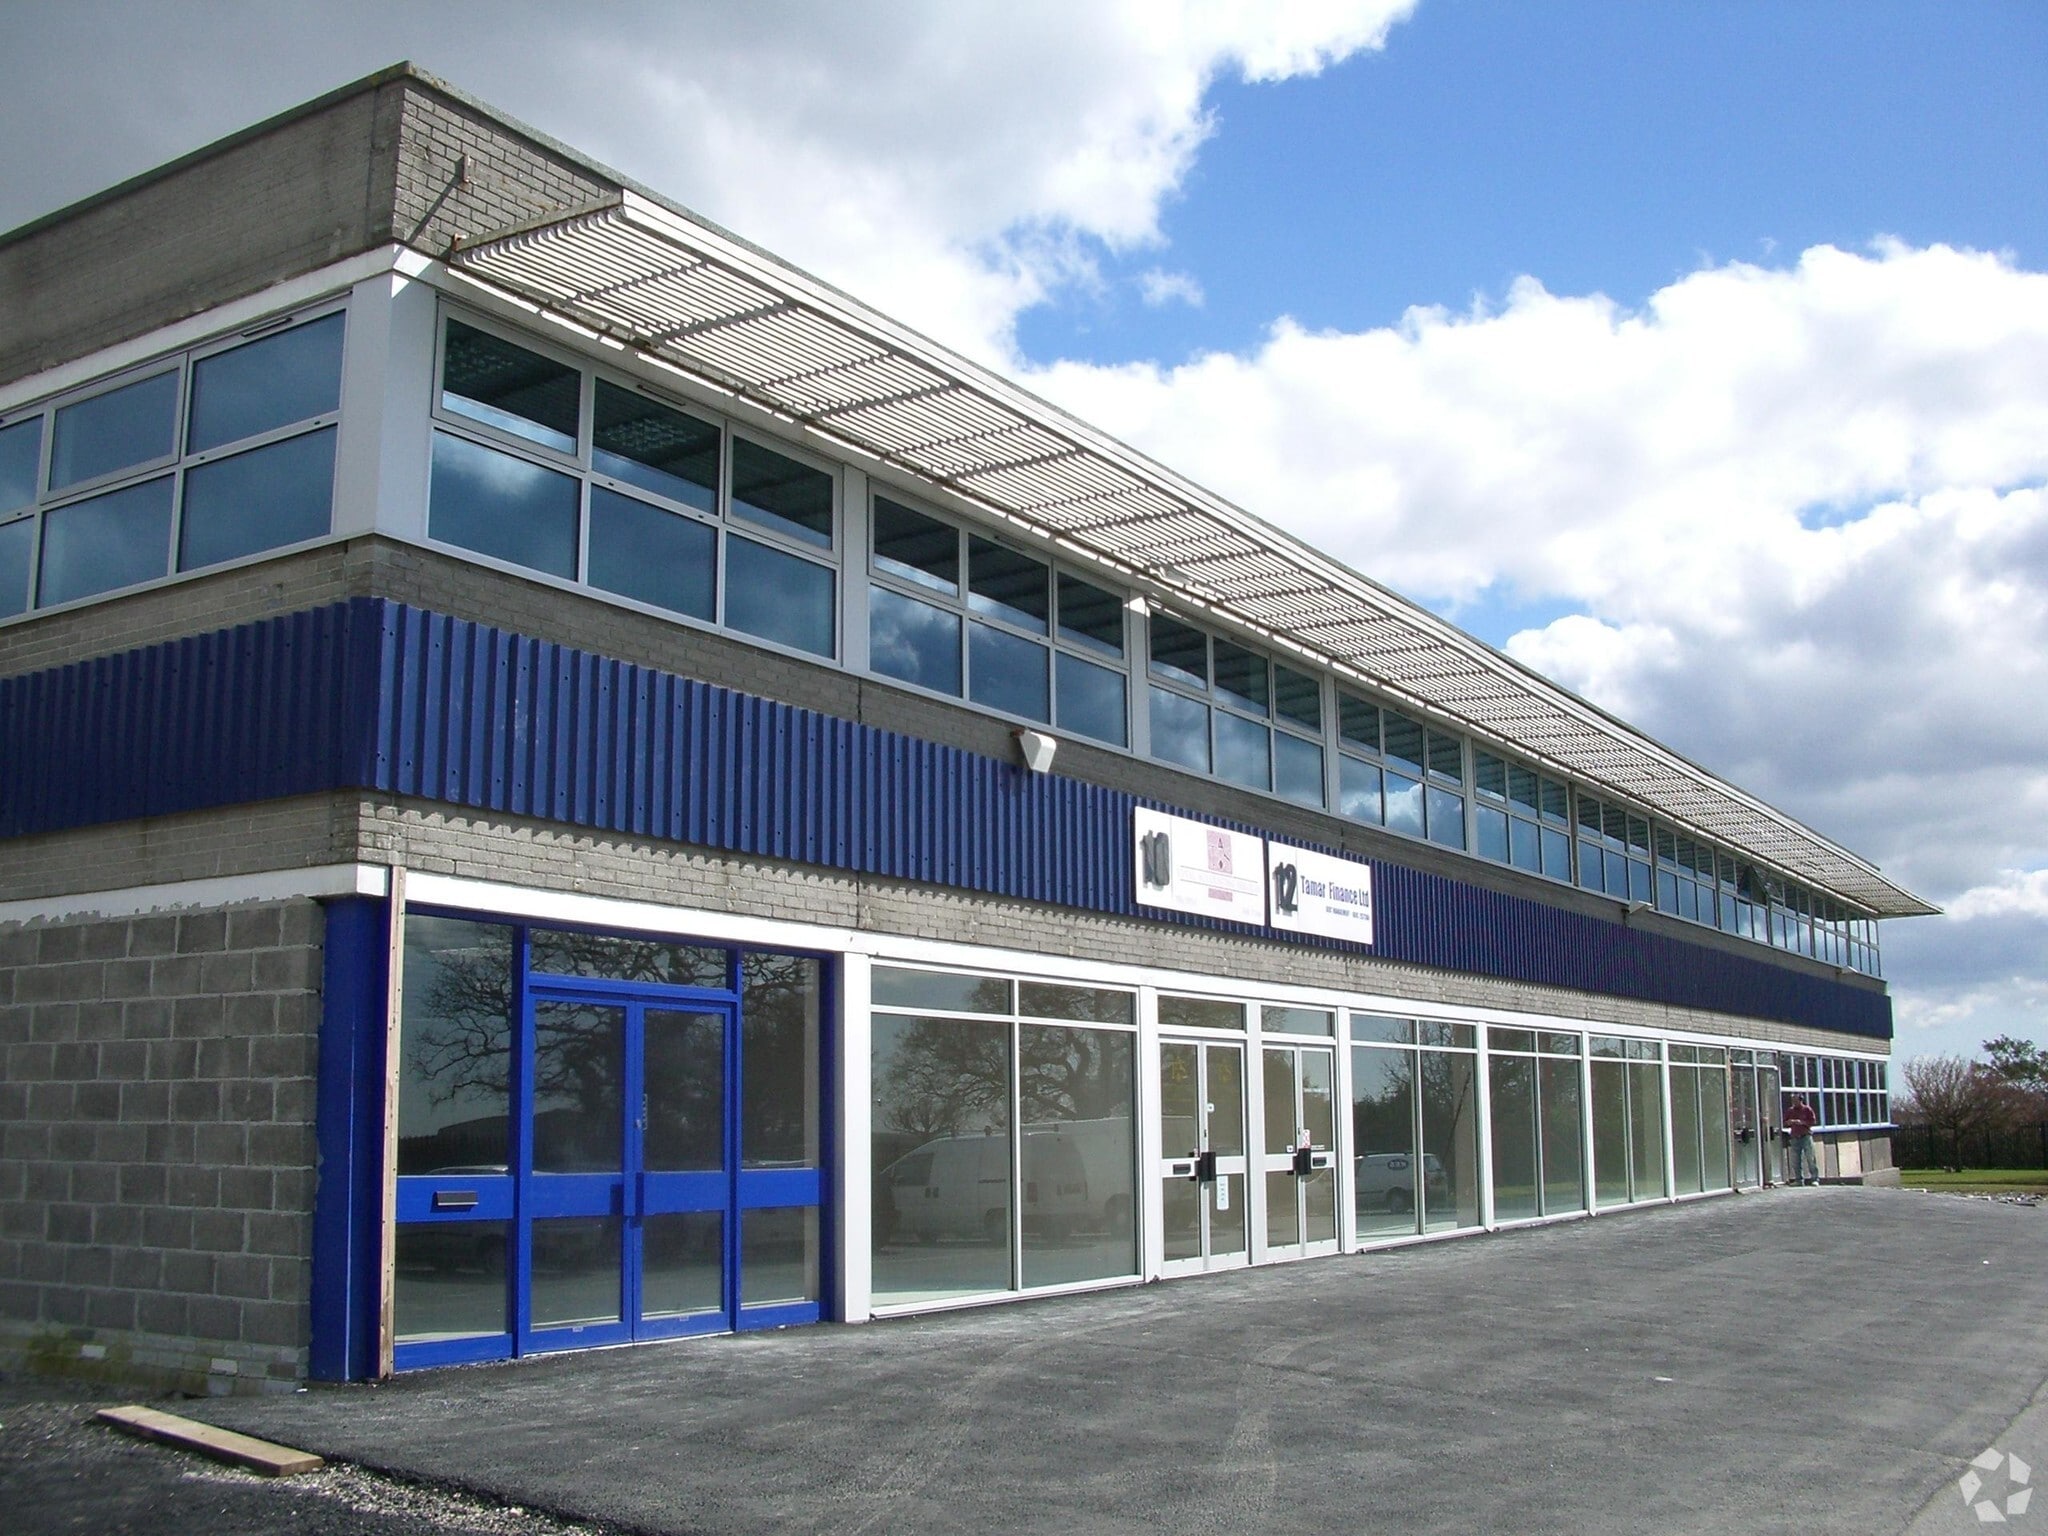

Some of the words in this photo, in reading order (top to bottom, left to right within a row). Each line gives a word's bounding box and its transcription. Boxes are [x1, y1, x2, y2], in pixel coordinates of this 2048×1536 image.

[1140, 830, 1170, 889] 10
[1273, 862, 1298, 914] 12
[1300, 875, 1326, 898] Tamar
[1328, 881, 1358, 905] Finance
[1358, 888, 1370, 908] Ltd
